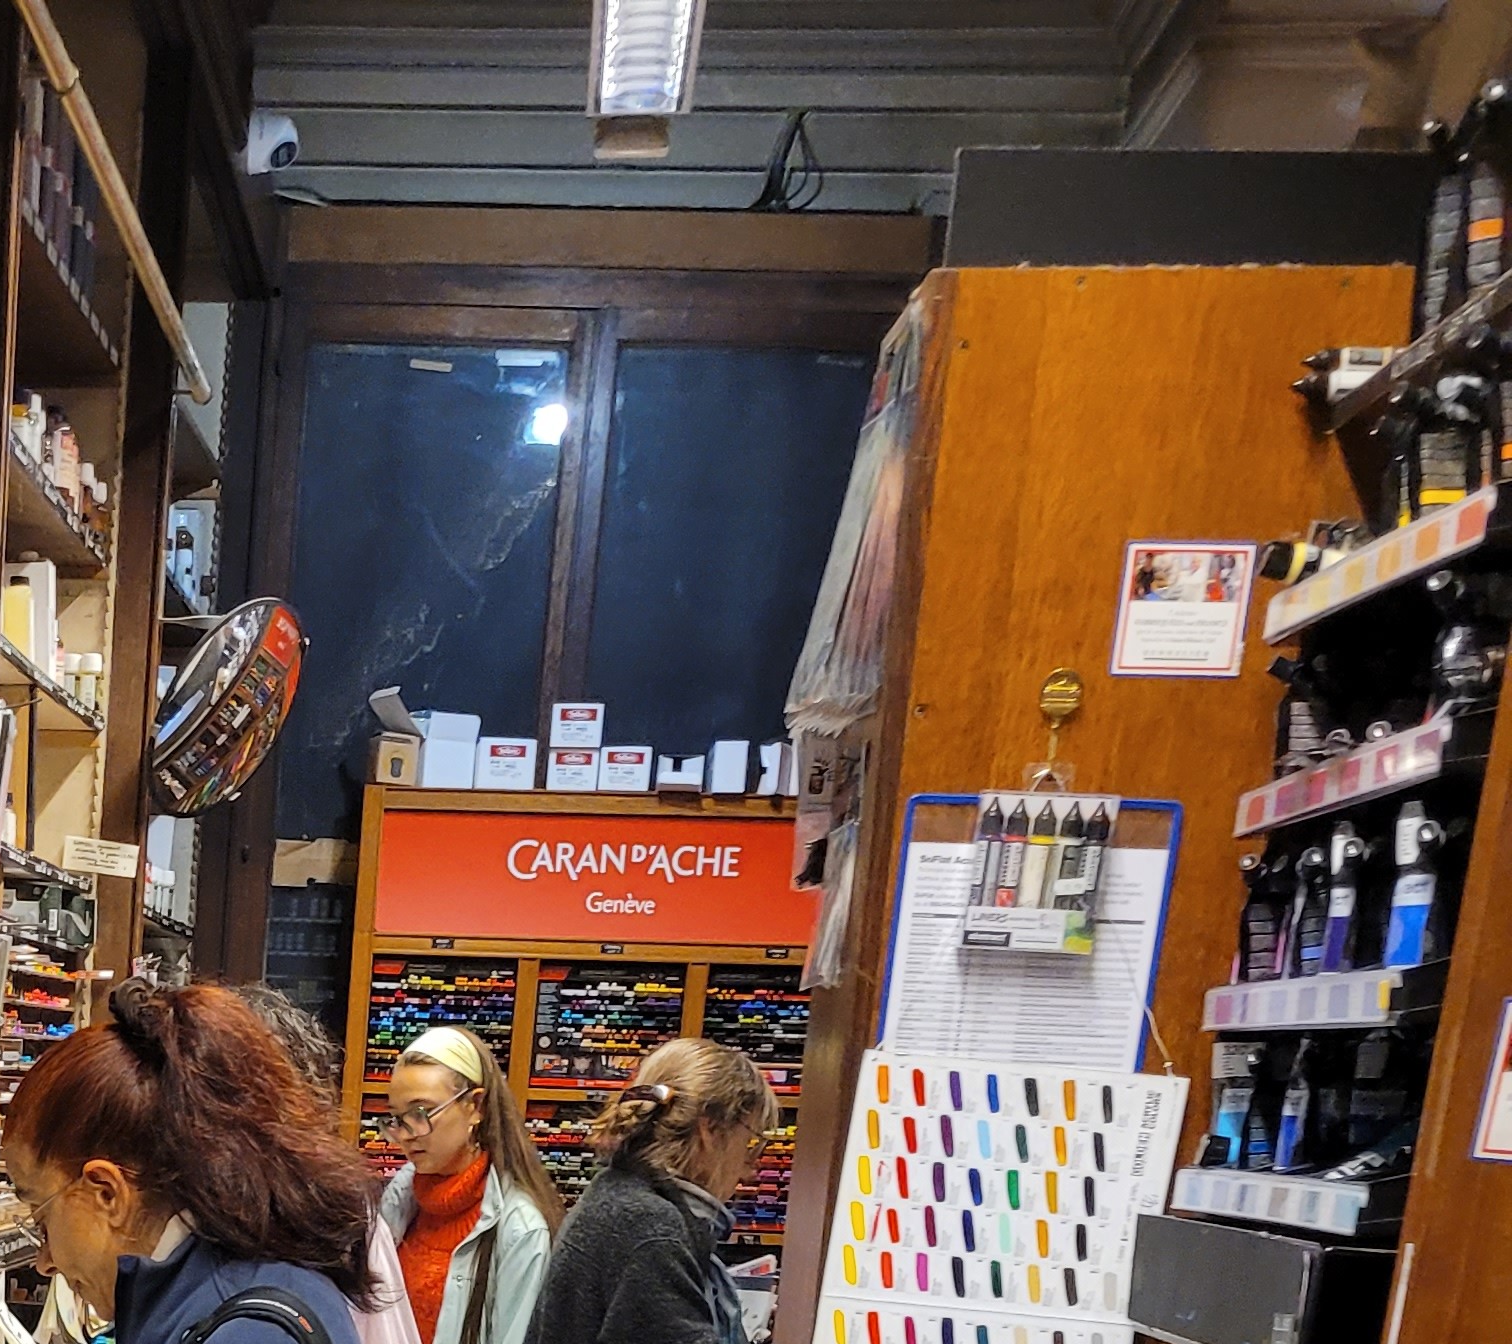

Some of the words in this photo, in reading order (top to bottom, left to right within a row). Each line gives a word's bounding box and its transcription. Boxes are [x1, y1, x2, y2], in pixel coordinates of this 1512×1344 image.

[507, 839, 626, 880] CARAN
[631, 844, 742, 883] D'ACHE
[586, 892, 656, 914] Genève
